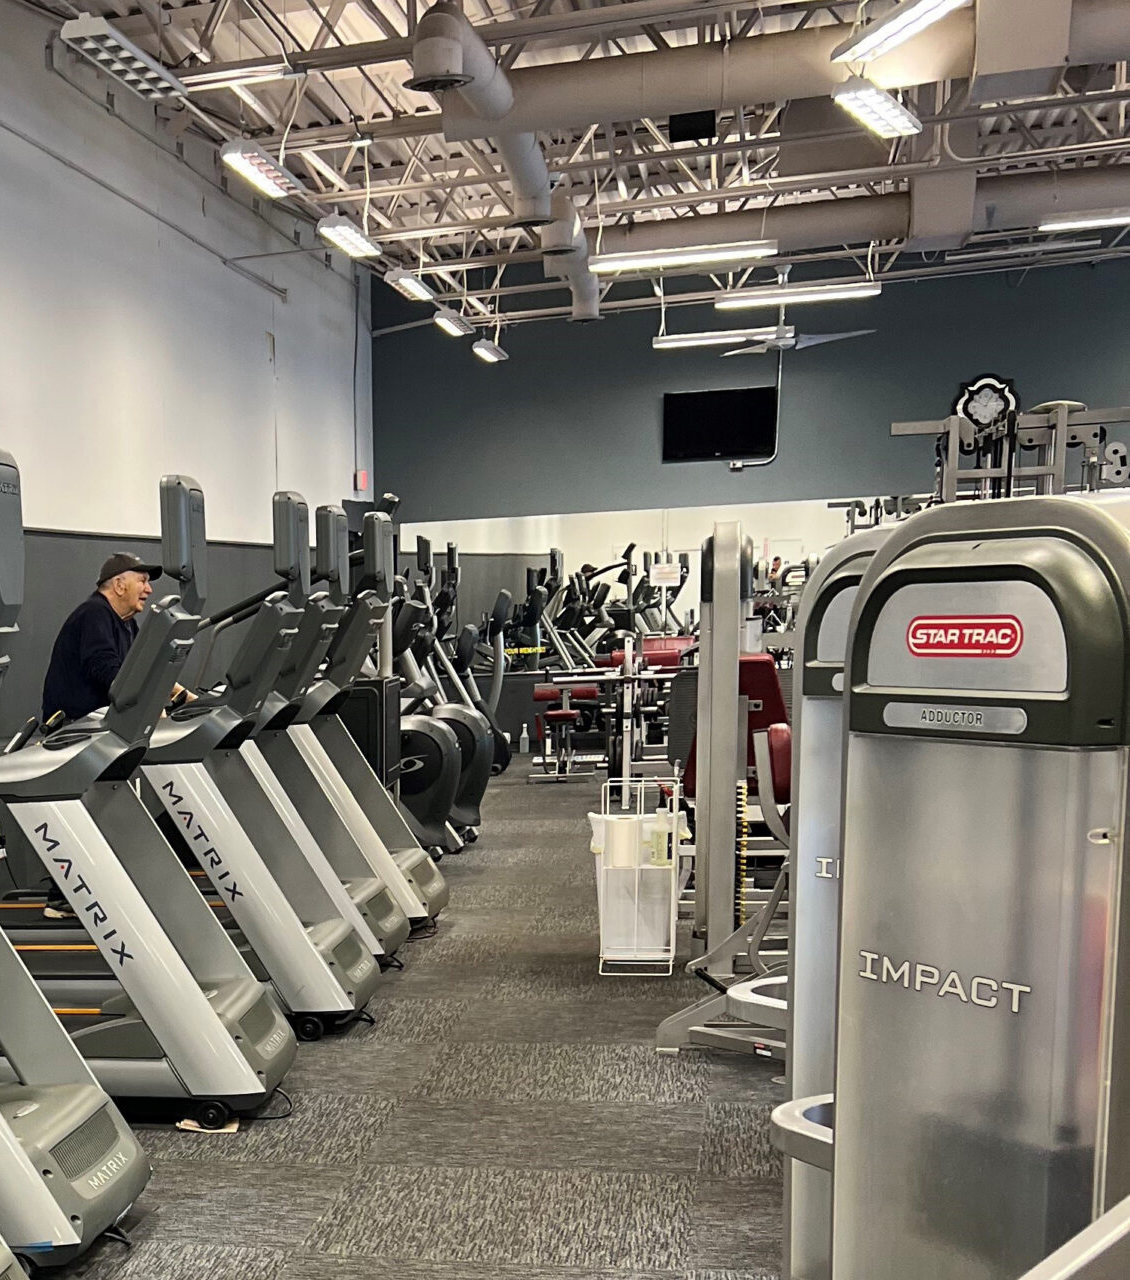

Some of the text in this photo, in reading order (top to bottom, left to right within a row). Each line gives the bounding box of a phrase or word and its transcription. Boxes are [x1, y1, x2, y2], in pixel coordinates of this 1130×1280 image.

[913, 628, 1012, 644] STAR TRAC
[920, 709, 984, 726] ADDUCTOR
[161, 780, 245, 903] MATRIX
[33, 821, 135, 968] MATRIX
[858, 949, 1032, 1014] IMPACT
[88, 1151, 129, 1190] MATRIX
